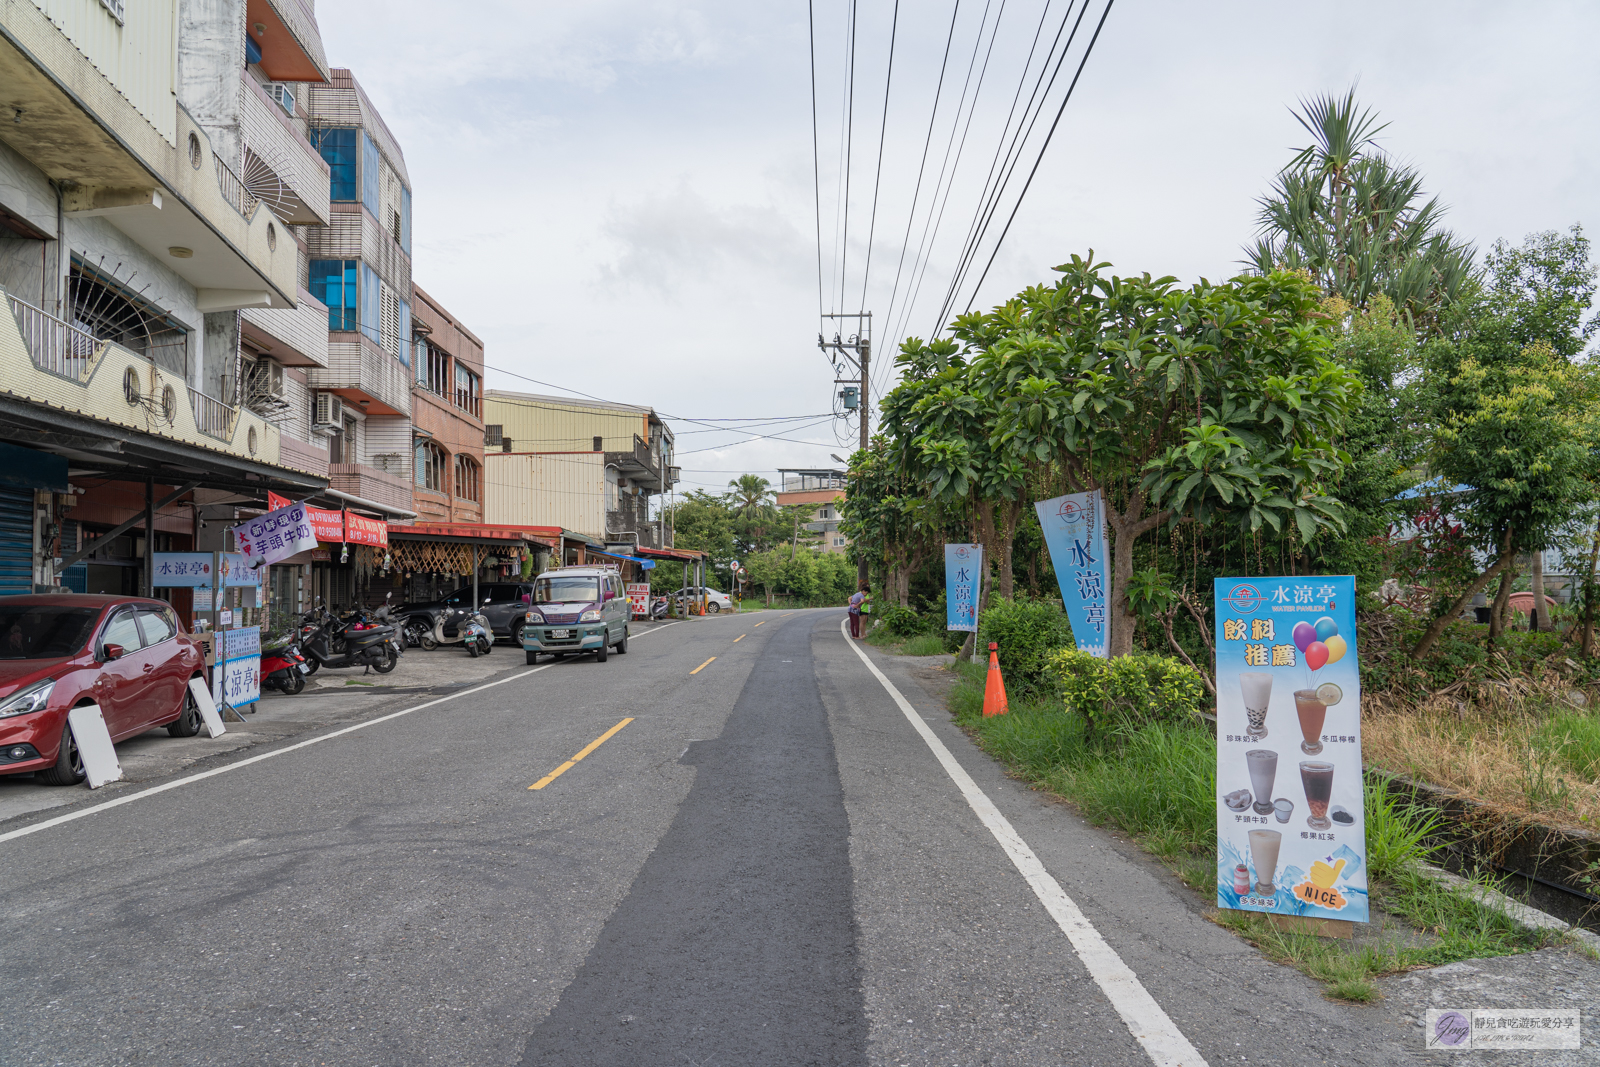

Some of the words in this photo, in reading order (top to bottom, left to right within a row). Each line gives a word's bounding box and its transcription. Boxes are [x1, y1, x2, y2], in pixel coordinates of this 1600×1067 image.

[250, 508, 304, 538] 新鮮現打
[239, 532, 252, 557] 大甲
[254, 524, 310, 555] 芋頭牛奶
[159, 562, 203, 575] 水涼亭
[954, 566, 972, 618] 水涼亭
[1066, 538, 1106, 633] 水涼亭
[1270, 584, 1337, 604] 水涼亭
[1223, 618, 1276, 642] 飲料
[1244, 644, 1296, 667] 推薦
[1226, 734, 1259, 743] 珍珠奶茶
[1322, 734, 1356, 743] 冬瓜檸檬
[1234, 814, 1268, 824] 芋頭牛奶
[1300, 832, 1336, 841] 椰果紅茶
[1240, 897, 1275, 907] 多多綠茶
[1304, 886, 1337, 906] NICE
